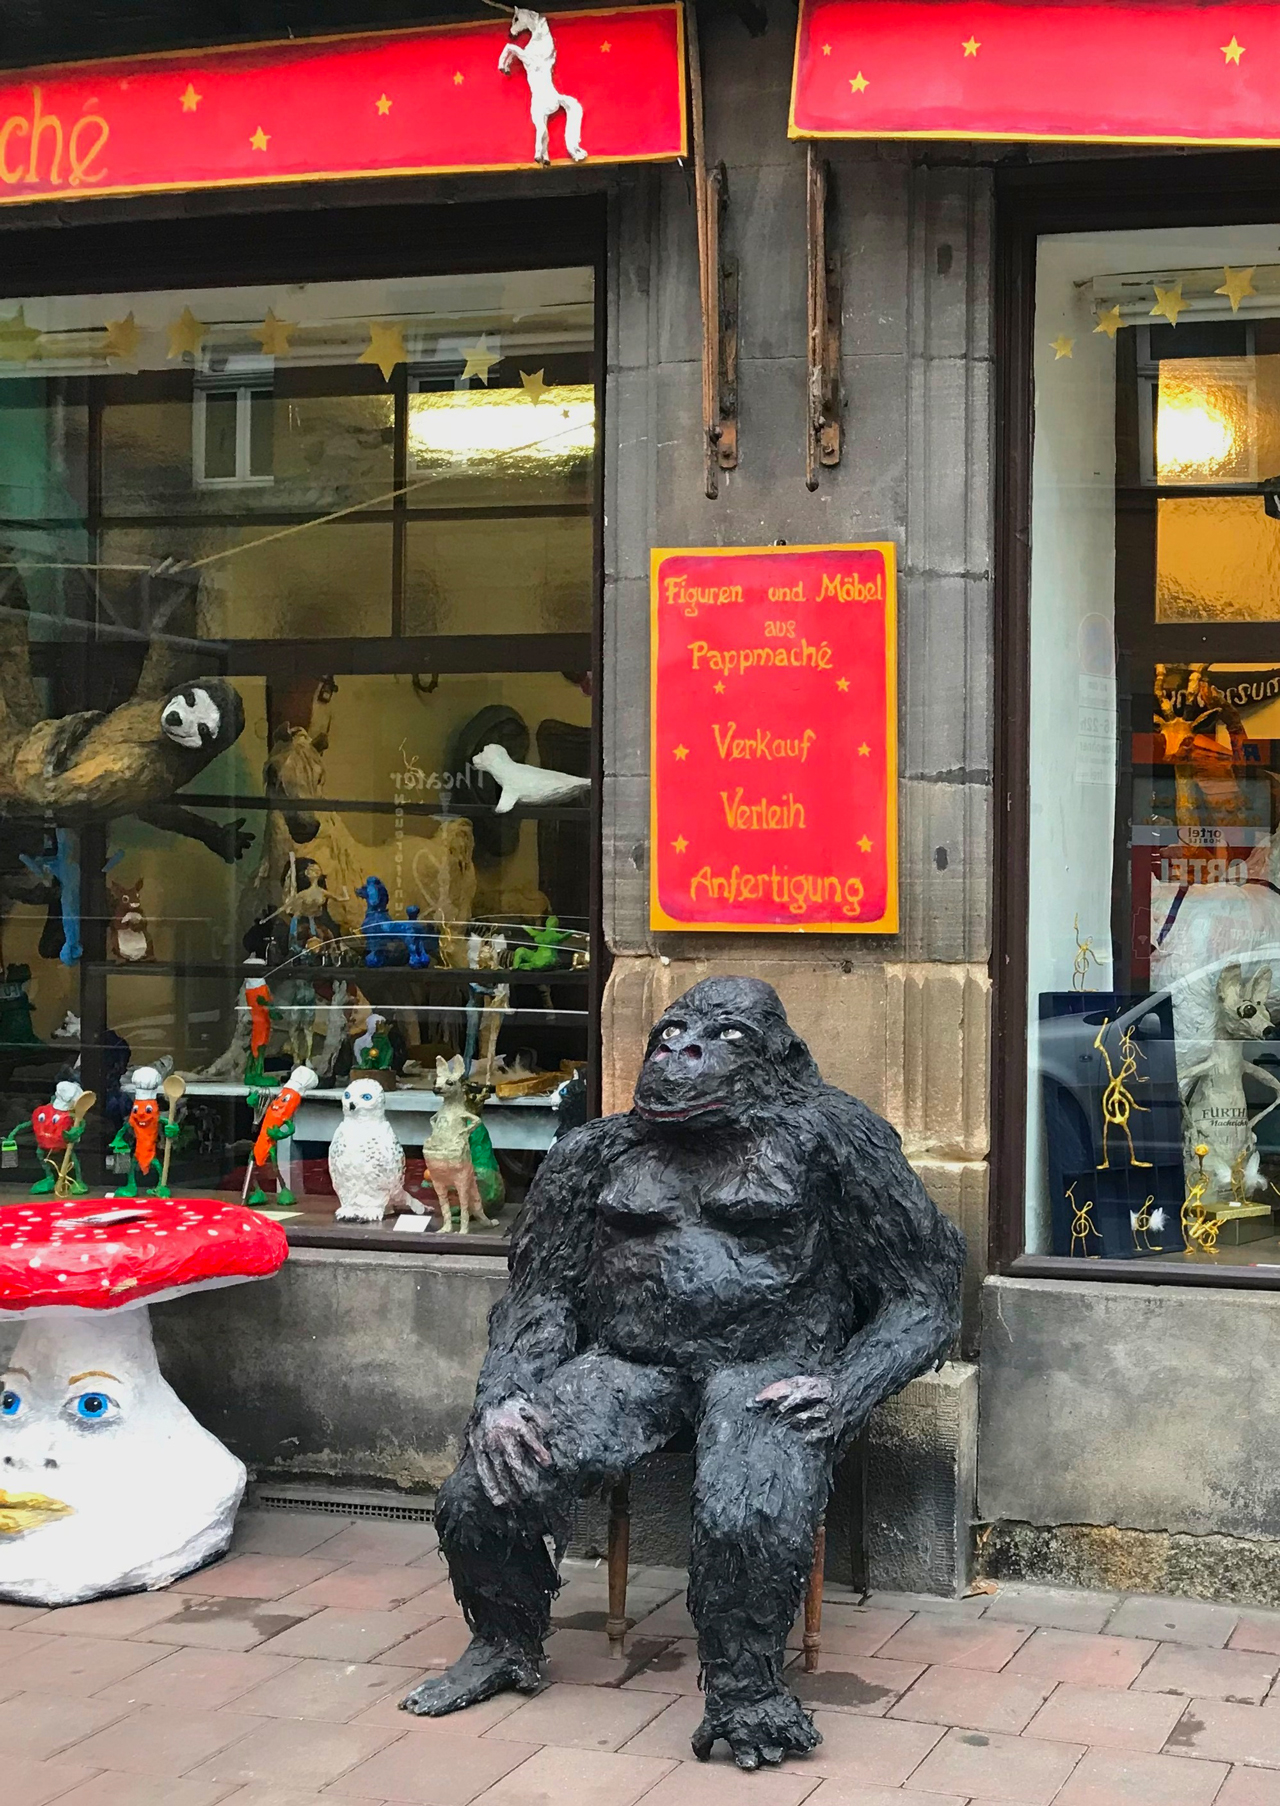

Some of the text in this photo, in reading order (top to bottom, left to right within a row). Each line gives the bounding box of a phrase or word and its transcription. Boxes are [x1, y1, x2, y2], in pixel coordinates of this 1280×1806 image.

[664, 572, 883, 617] Figuren und Möbel
[764, 620, 796, 639] aus
[686, 638, 833, 676] Pappmaché
[711, 721, 816, 763] Verkauf
[719, 786, 806, 830] Verleih
[690, 865, 864, 916] Anfertigung
